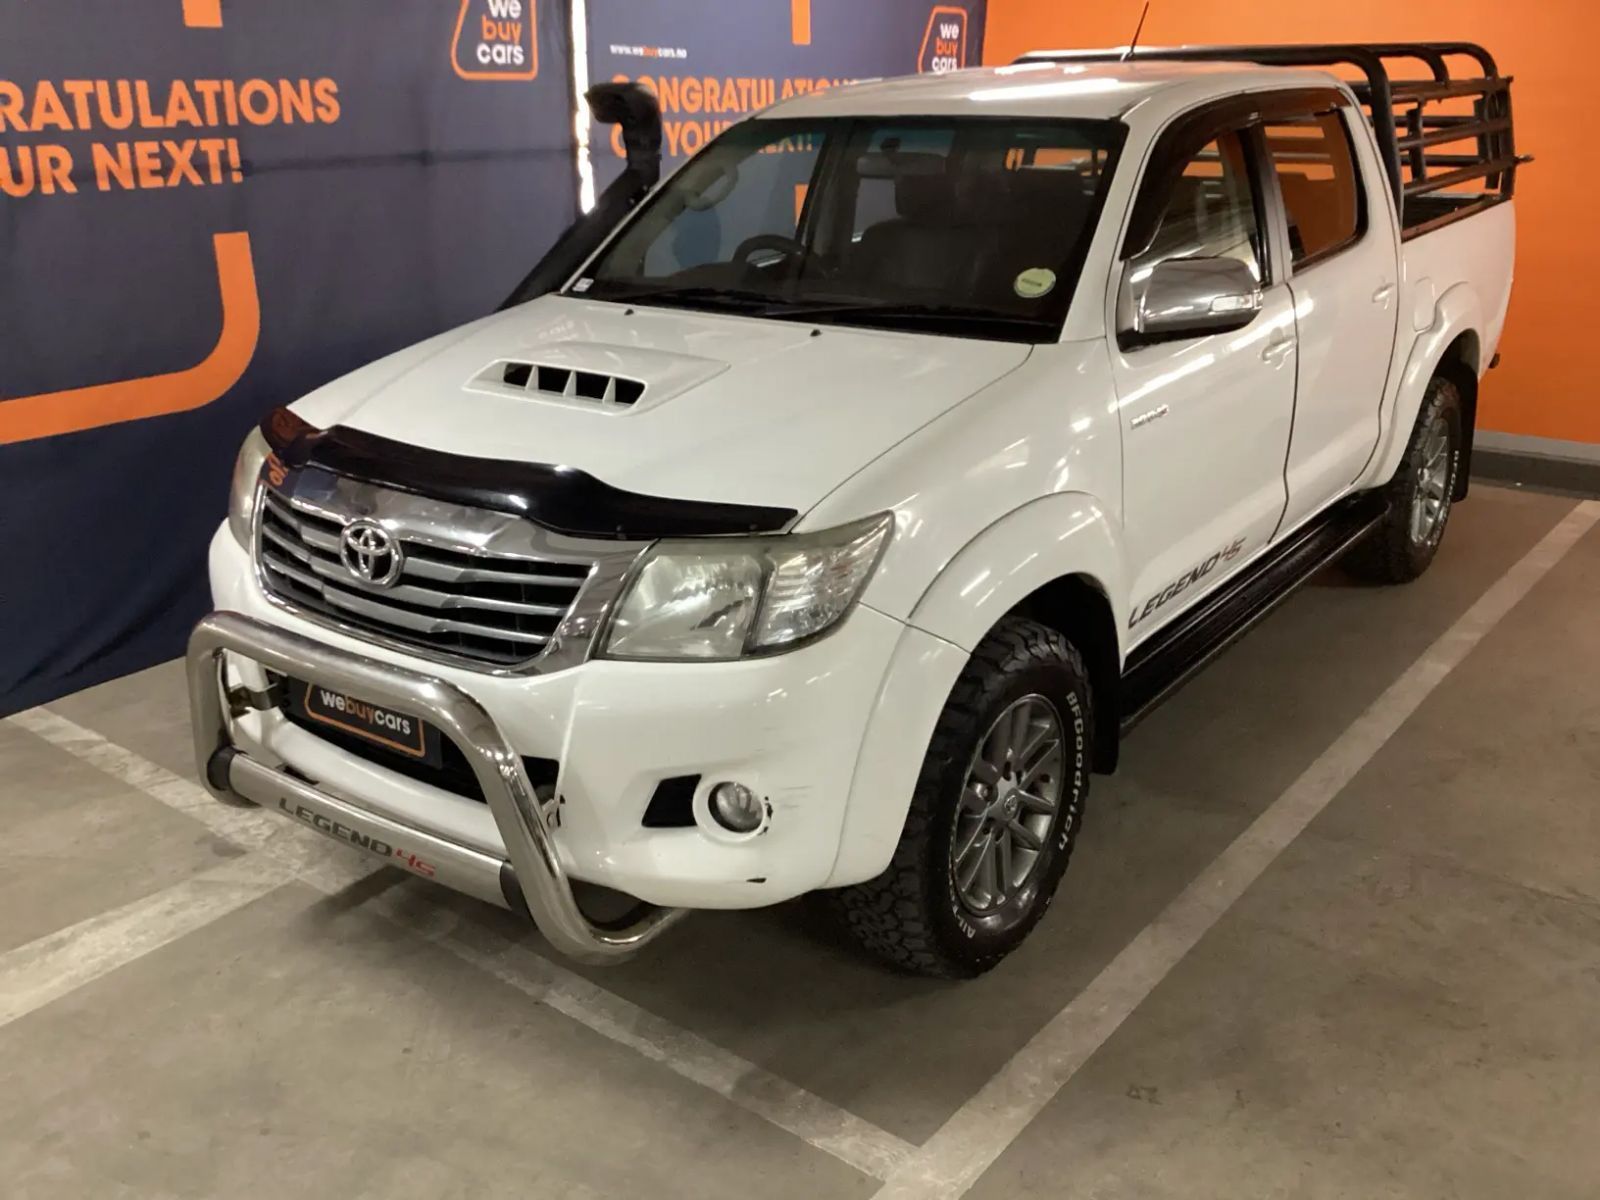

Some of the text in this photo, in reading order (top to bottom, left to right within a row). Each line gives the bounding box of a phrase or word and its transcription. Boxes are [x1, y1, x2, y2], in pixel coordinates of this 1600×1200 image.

[488, 0, 522, 18] we
[482, 15, 521, 46] buy
[940, 24, 960, 39] we
[477, 43, 524, 65] cars
[936, 38, 958, 56] buy
[932, 56, 958, 75] cars
[92, 138, 243, 191] NEXT!
